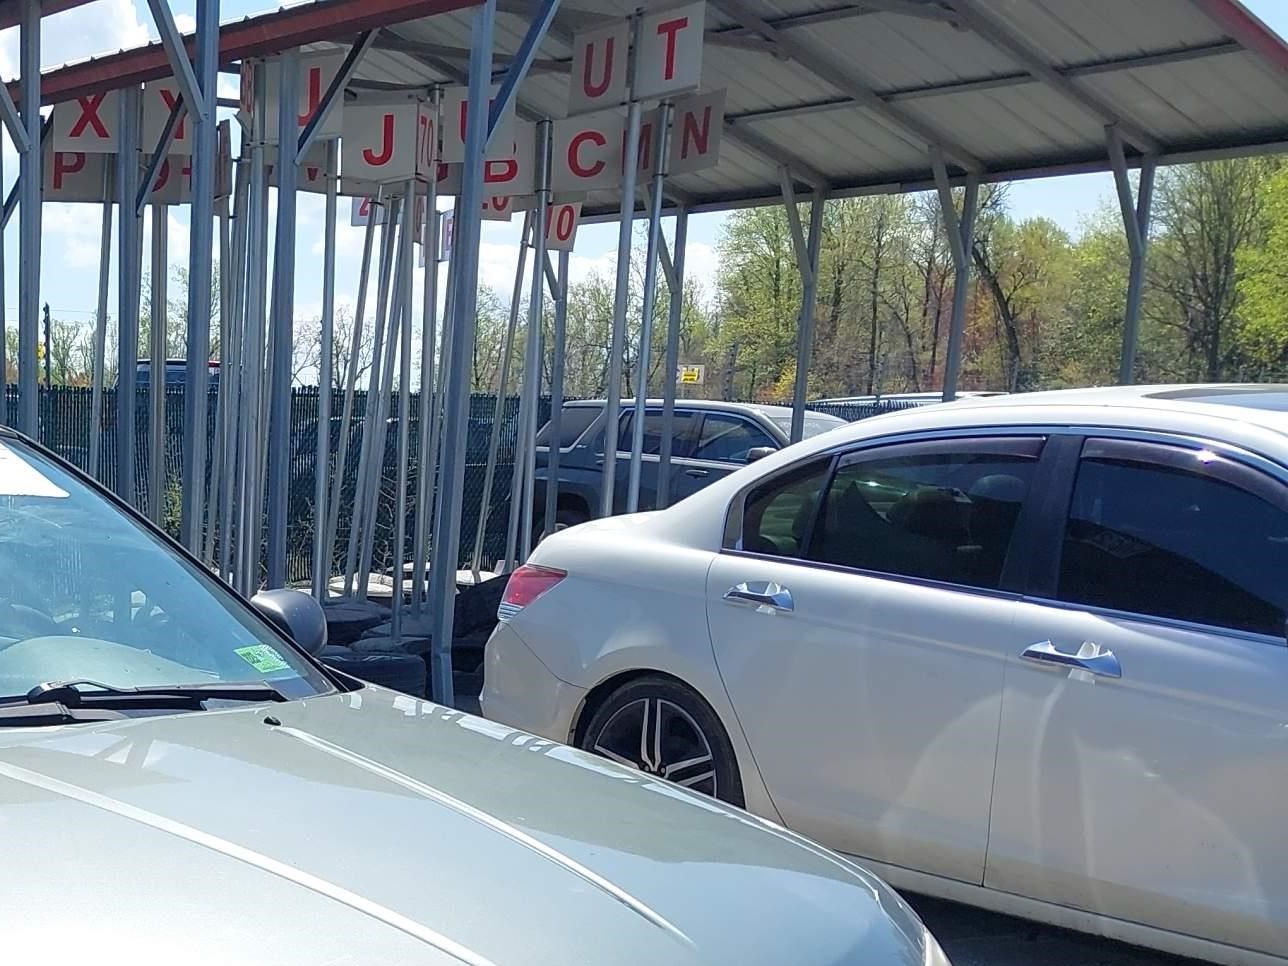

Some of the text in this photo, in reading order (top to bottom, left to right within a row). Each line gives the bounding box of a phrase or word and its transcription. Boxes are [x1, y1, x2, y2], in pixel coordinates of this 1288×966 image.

[584, 37, 614, 98] U
[657, 17, 688, 80] T
[69, 90, 110, 138] X
[681, 106, 712, 160] N
[363, 115, 394, 166] J
[568, 131, 607, 178] C
[53, 152, 86, 189] P
